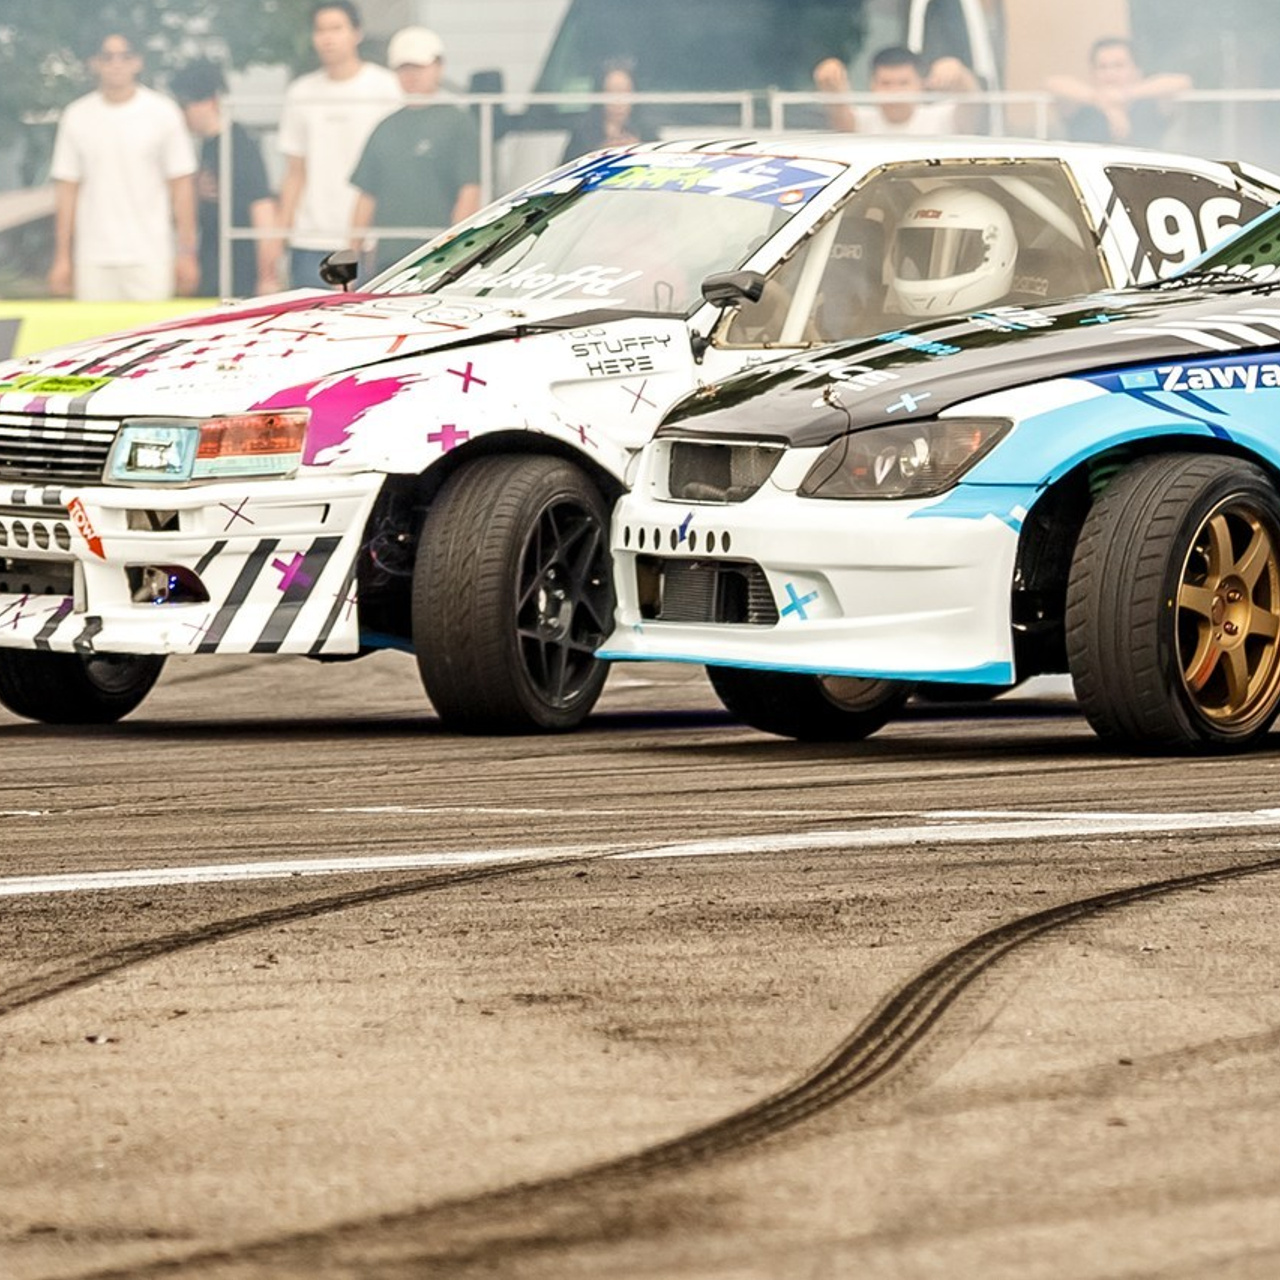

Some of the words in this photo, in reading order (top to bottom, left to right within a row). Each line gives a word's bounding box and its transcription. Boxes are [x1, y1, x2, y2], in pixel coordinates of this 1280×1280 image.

[571, 334, 671, 358] STUFFY
[587, 355, 653, 377] HERE
[69, 501, 97, 540] TOW
